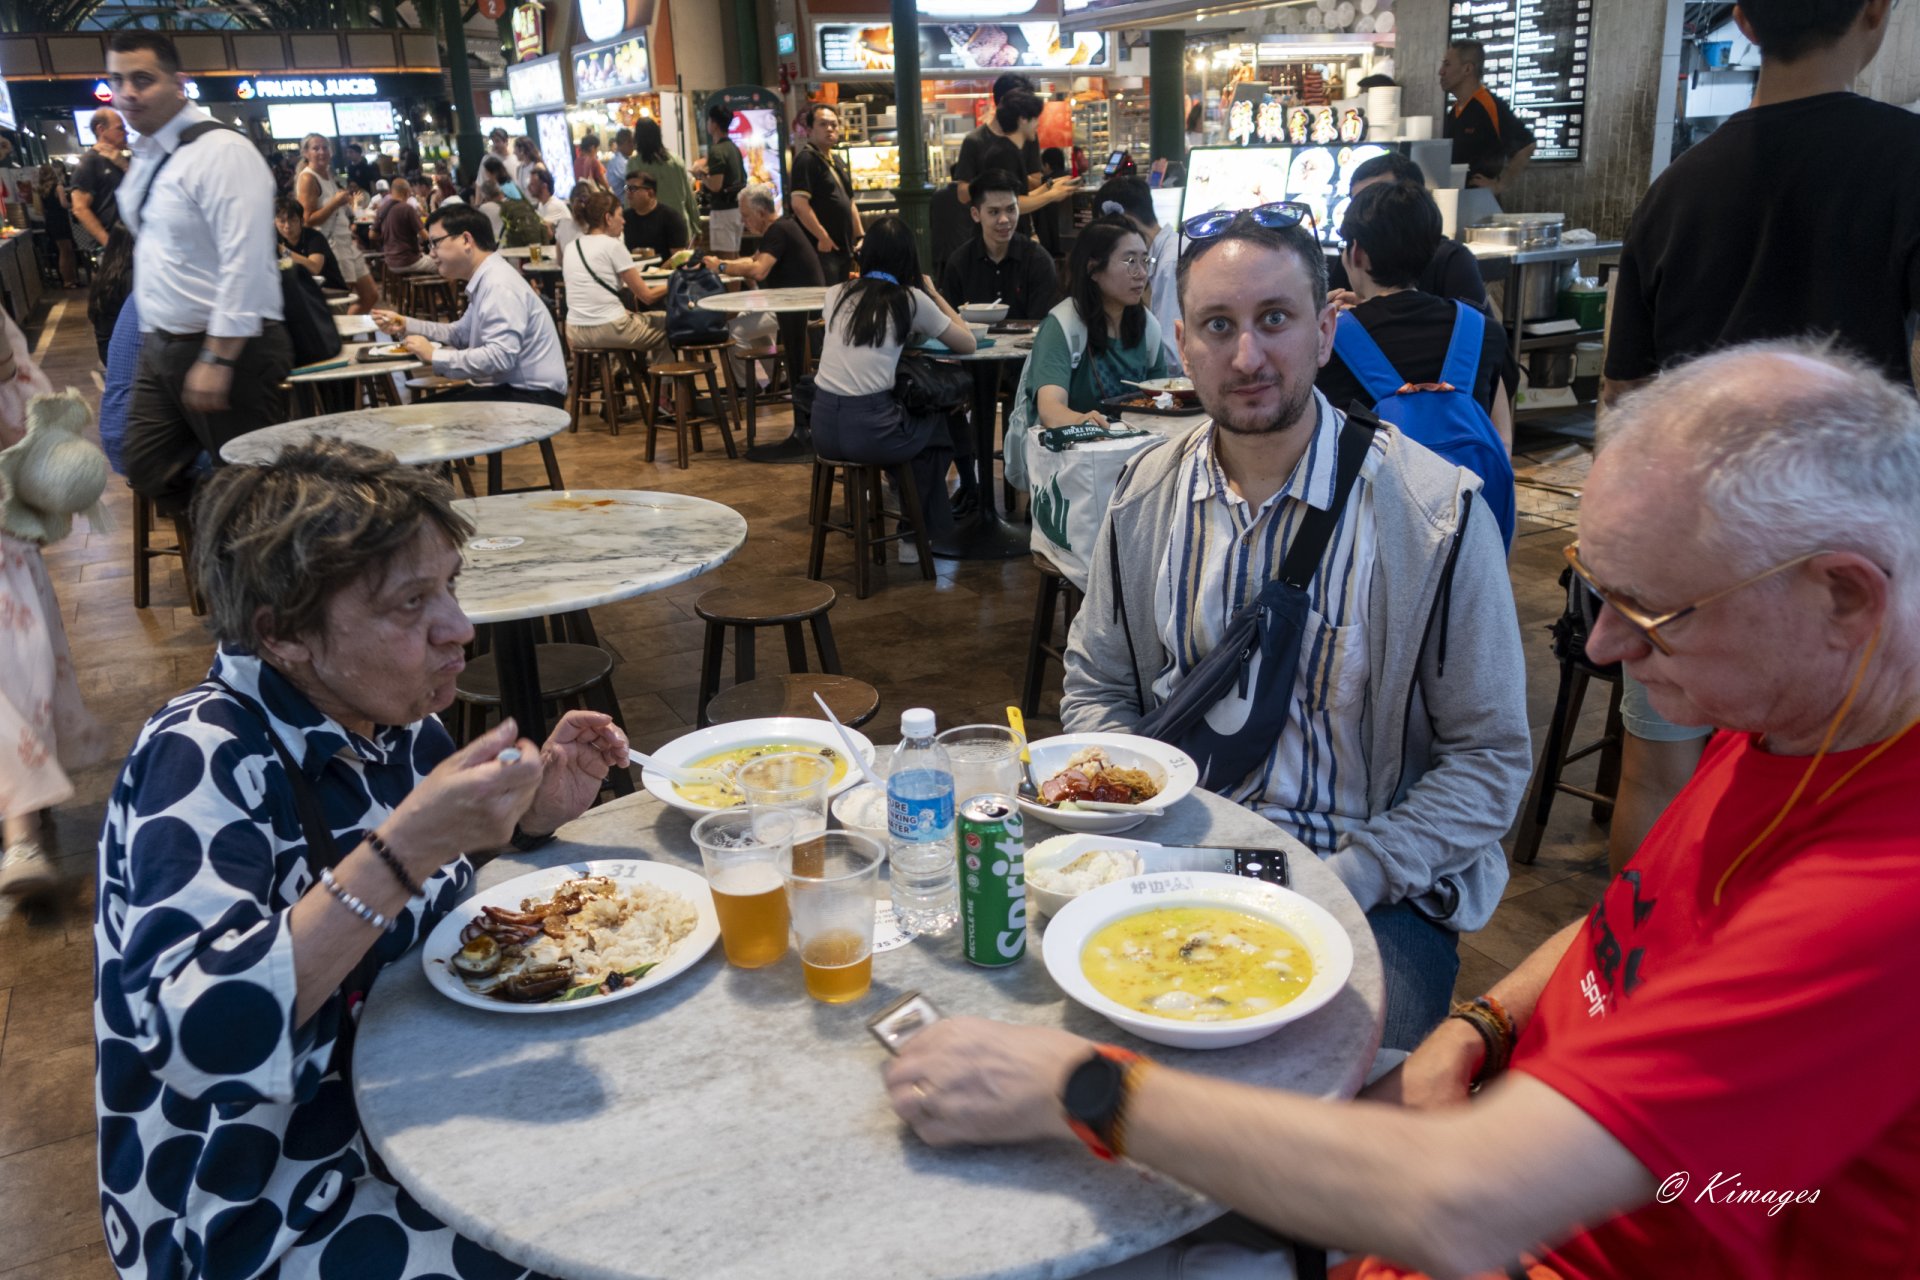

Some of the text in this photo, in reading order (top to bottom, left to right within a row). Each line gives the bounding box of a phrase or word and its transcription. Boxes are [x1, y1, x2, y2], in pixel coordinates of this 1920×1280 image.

[488, 0, 497, 15] 2
[257, 78, 377, 97] FRUITS & JUICES
[1062, 425, 1084, 436] WHOLE
[607, 864, 638, 878] 31
[968, 898, 976, 959] RECYCLE ME
